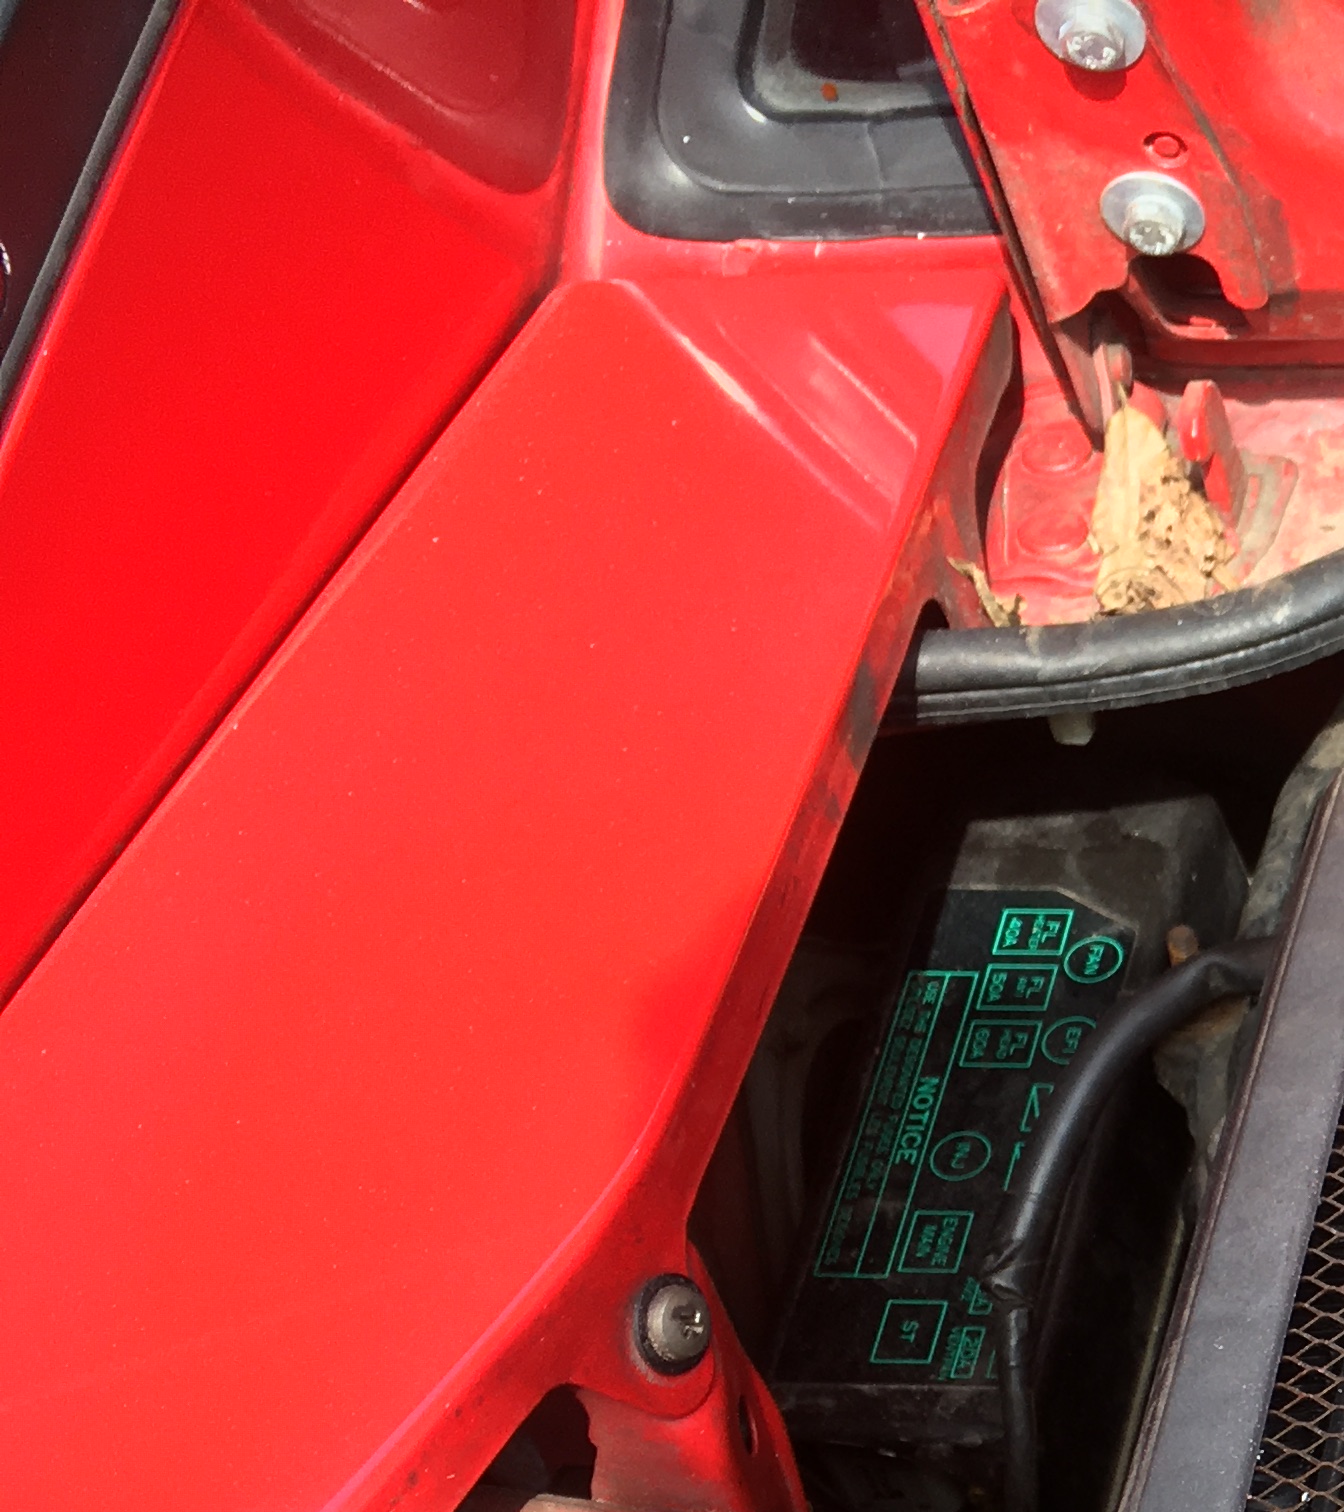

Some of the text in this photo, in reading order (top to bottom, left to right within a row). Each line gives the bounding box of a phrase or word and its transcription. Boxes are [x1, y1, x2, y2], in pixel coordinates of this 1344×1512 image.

[1002, 917, 1023, 948] 40A
[1042, 921, 1062, 943] FL
[1084, 944, 1105, 975] FAN
[923, 981, 940, 1005] USE
[987, 972, 1008, 1002] 50A
[1026, 976, 1045, 999] FL
[1010, 1032, 1029, 1056] FL
[1063, 1026, 1083, 1054] EFI
[894, 1076, 941, 1165] NOTICE
[931, 1217, 959, 1266] ENGINE
[900, 1320, 920, 1343] ST
